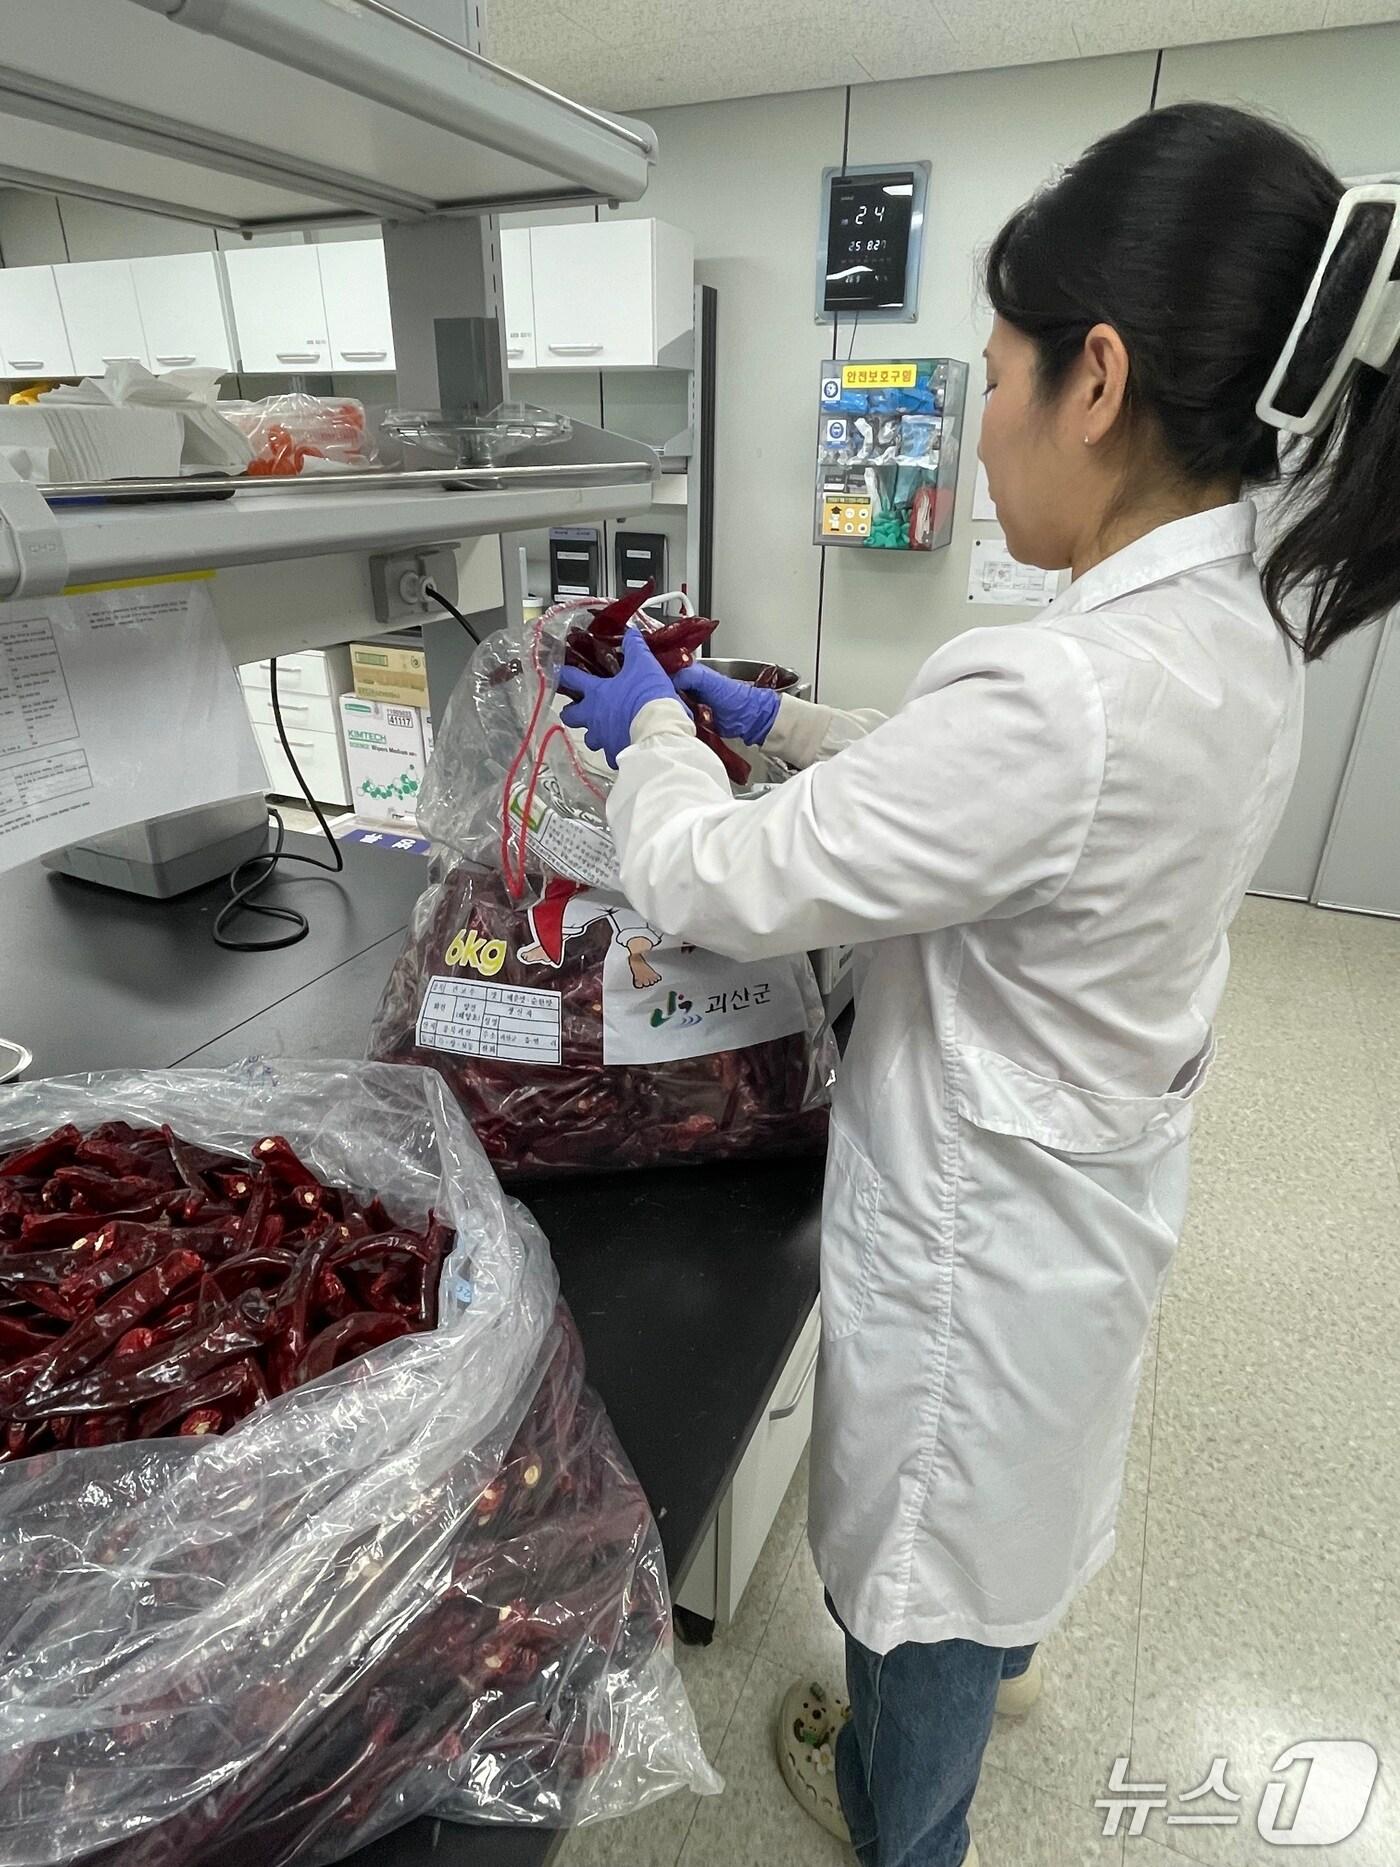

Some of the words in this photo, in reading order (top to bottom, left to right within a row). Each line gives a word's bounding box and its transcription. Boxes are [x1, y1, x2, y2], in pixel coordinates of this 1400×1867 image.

[347, 729, 386, 742] KIMTECH
[445, 929, 508, 975] 6kg
[705, 983, 772, 1014] 괴산군
